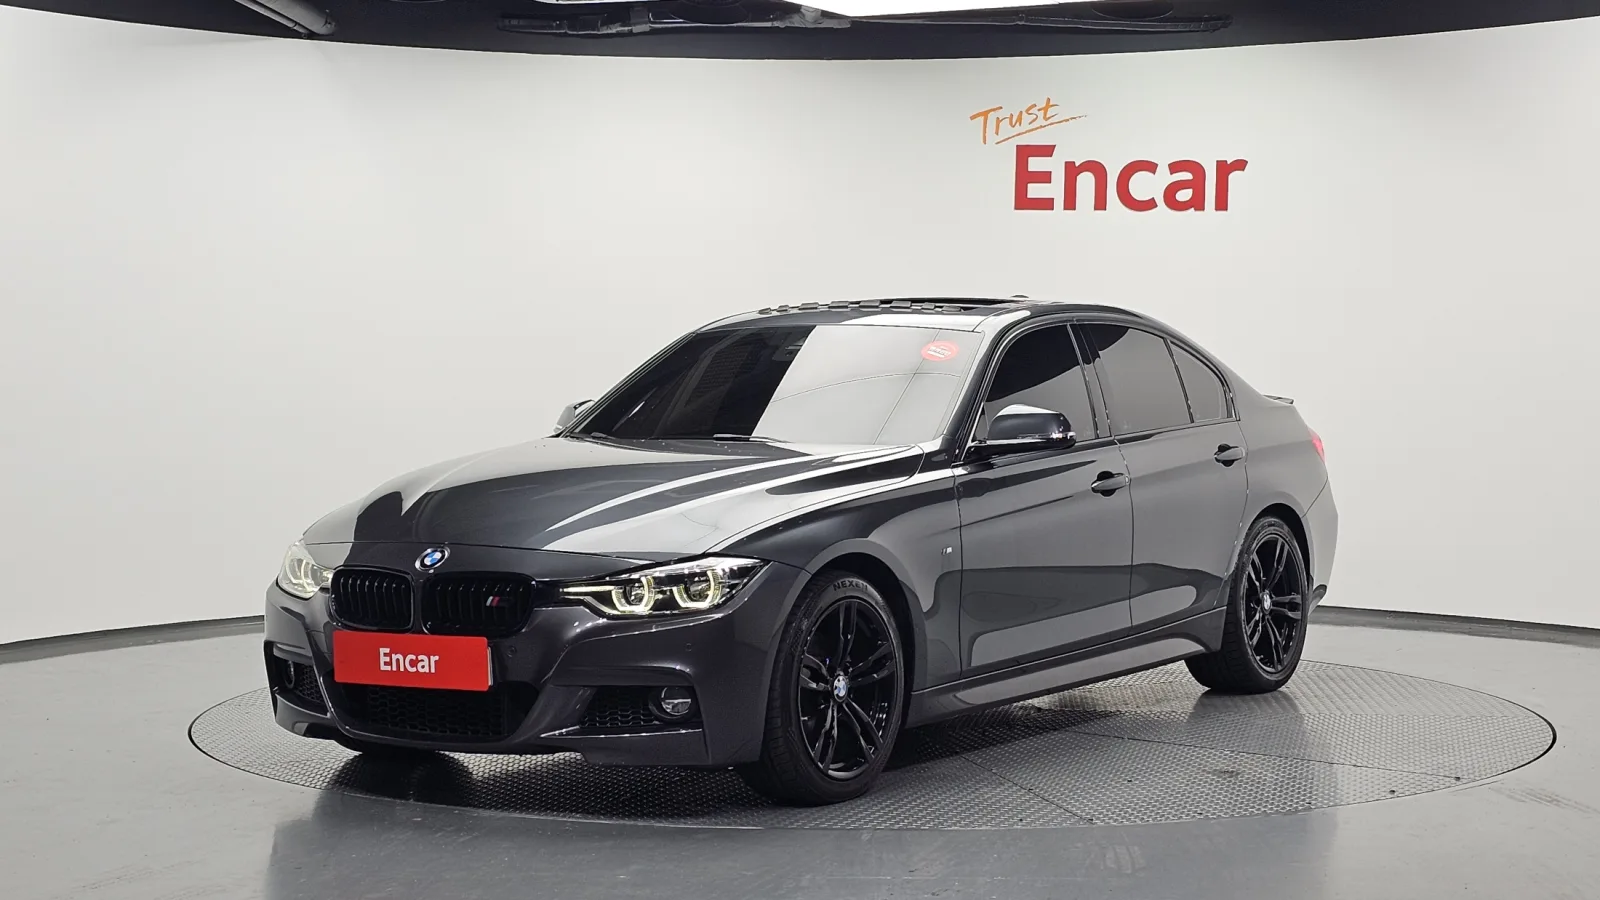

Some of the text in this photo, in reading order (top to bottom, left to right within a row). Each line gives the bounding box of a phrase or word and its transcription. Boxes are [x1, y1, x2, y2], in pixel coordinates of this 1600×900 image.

[969, 97, 1060, 145] Trust
[1014, 144, 1248, 212] Encar
[832, 579, 868, 592] NEXEN
[379, 647, 440, 673] Encar
